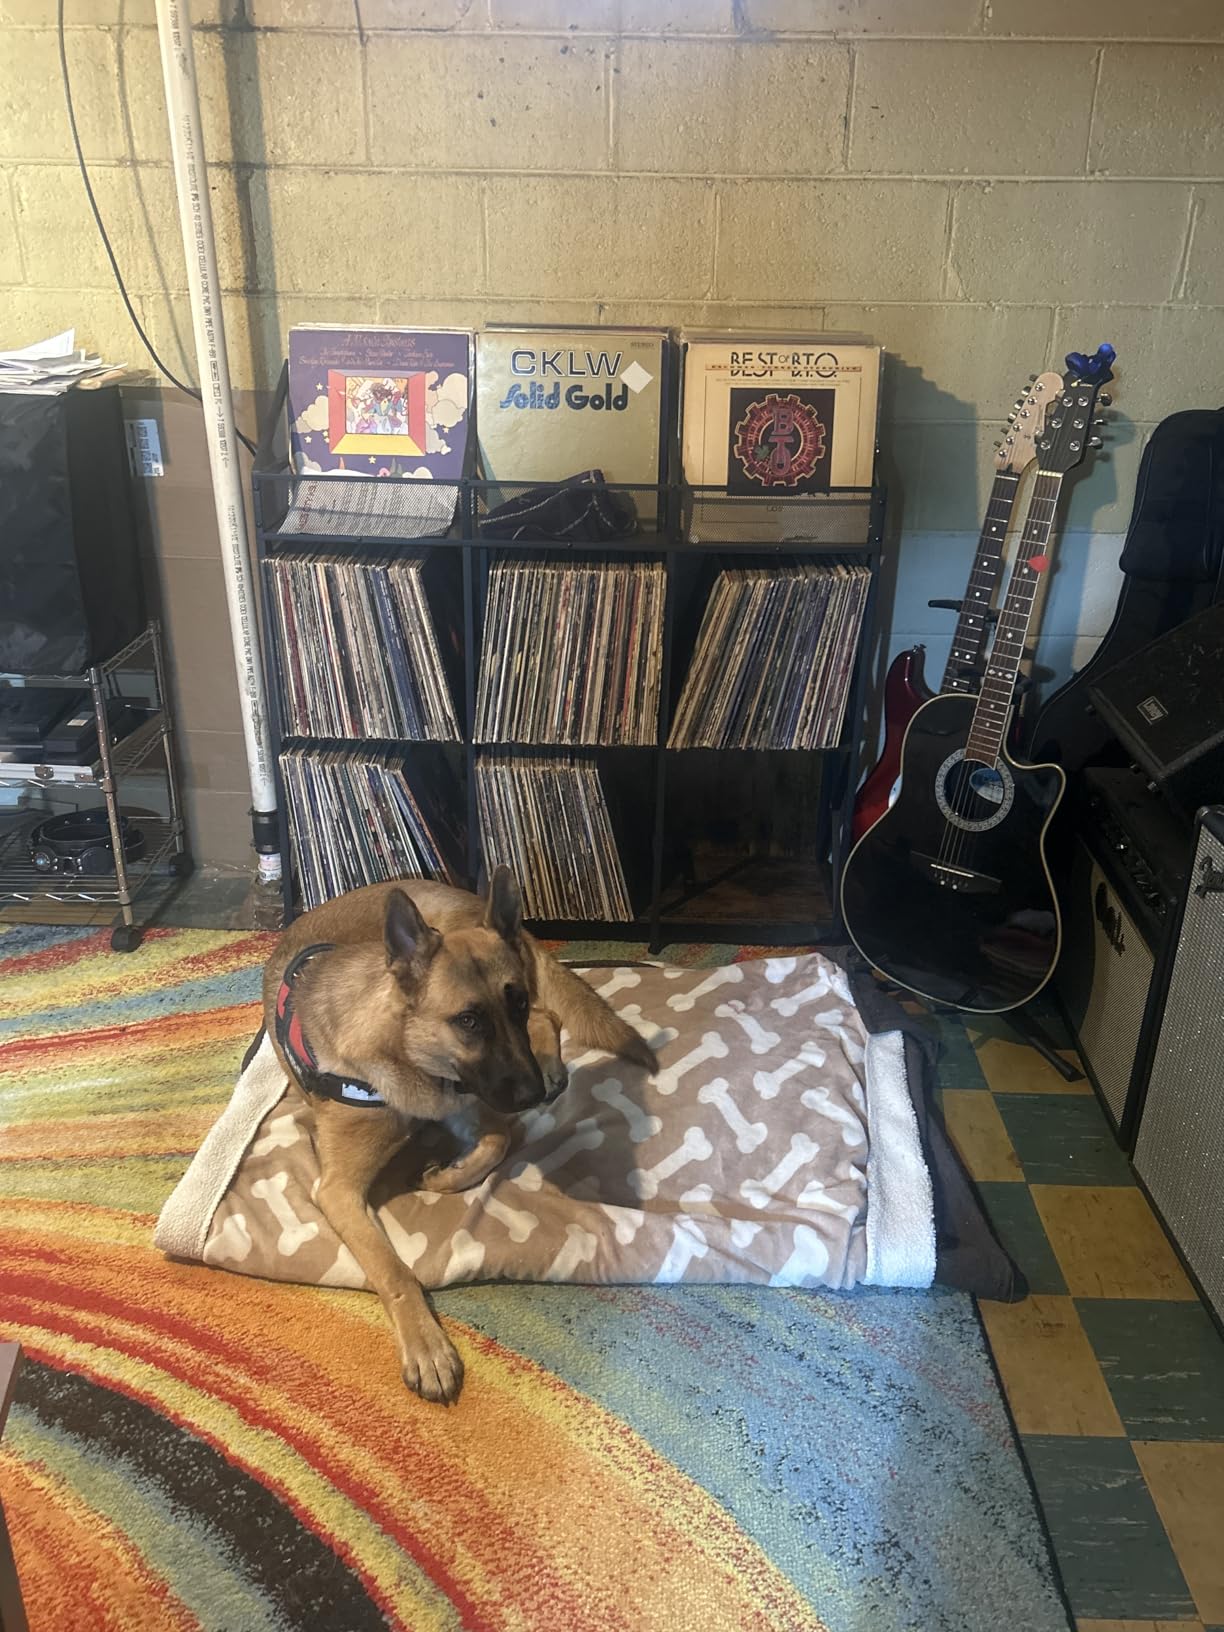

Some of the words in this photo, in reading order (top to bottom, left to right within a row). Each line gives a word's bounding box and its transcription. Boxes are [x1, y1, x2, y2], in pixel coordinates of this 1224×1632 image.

[511, 350, 622, 378] CKLW
[731, 352, 778, 377] BEST
[500, 381, 560, 410] Solid
[565, 382, 628, 411] Gold
